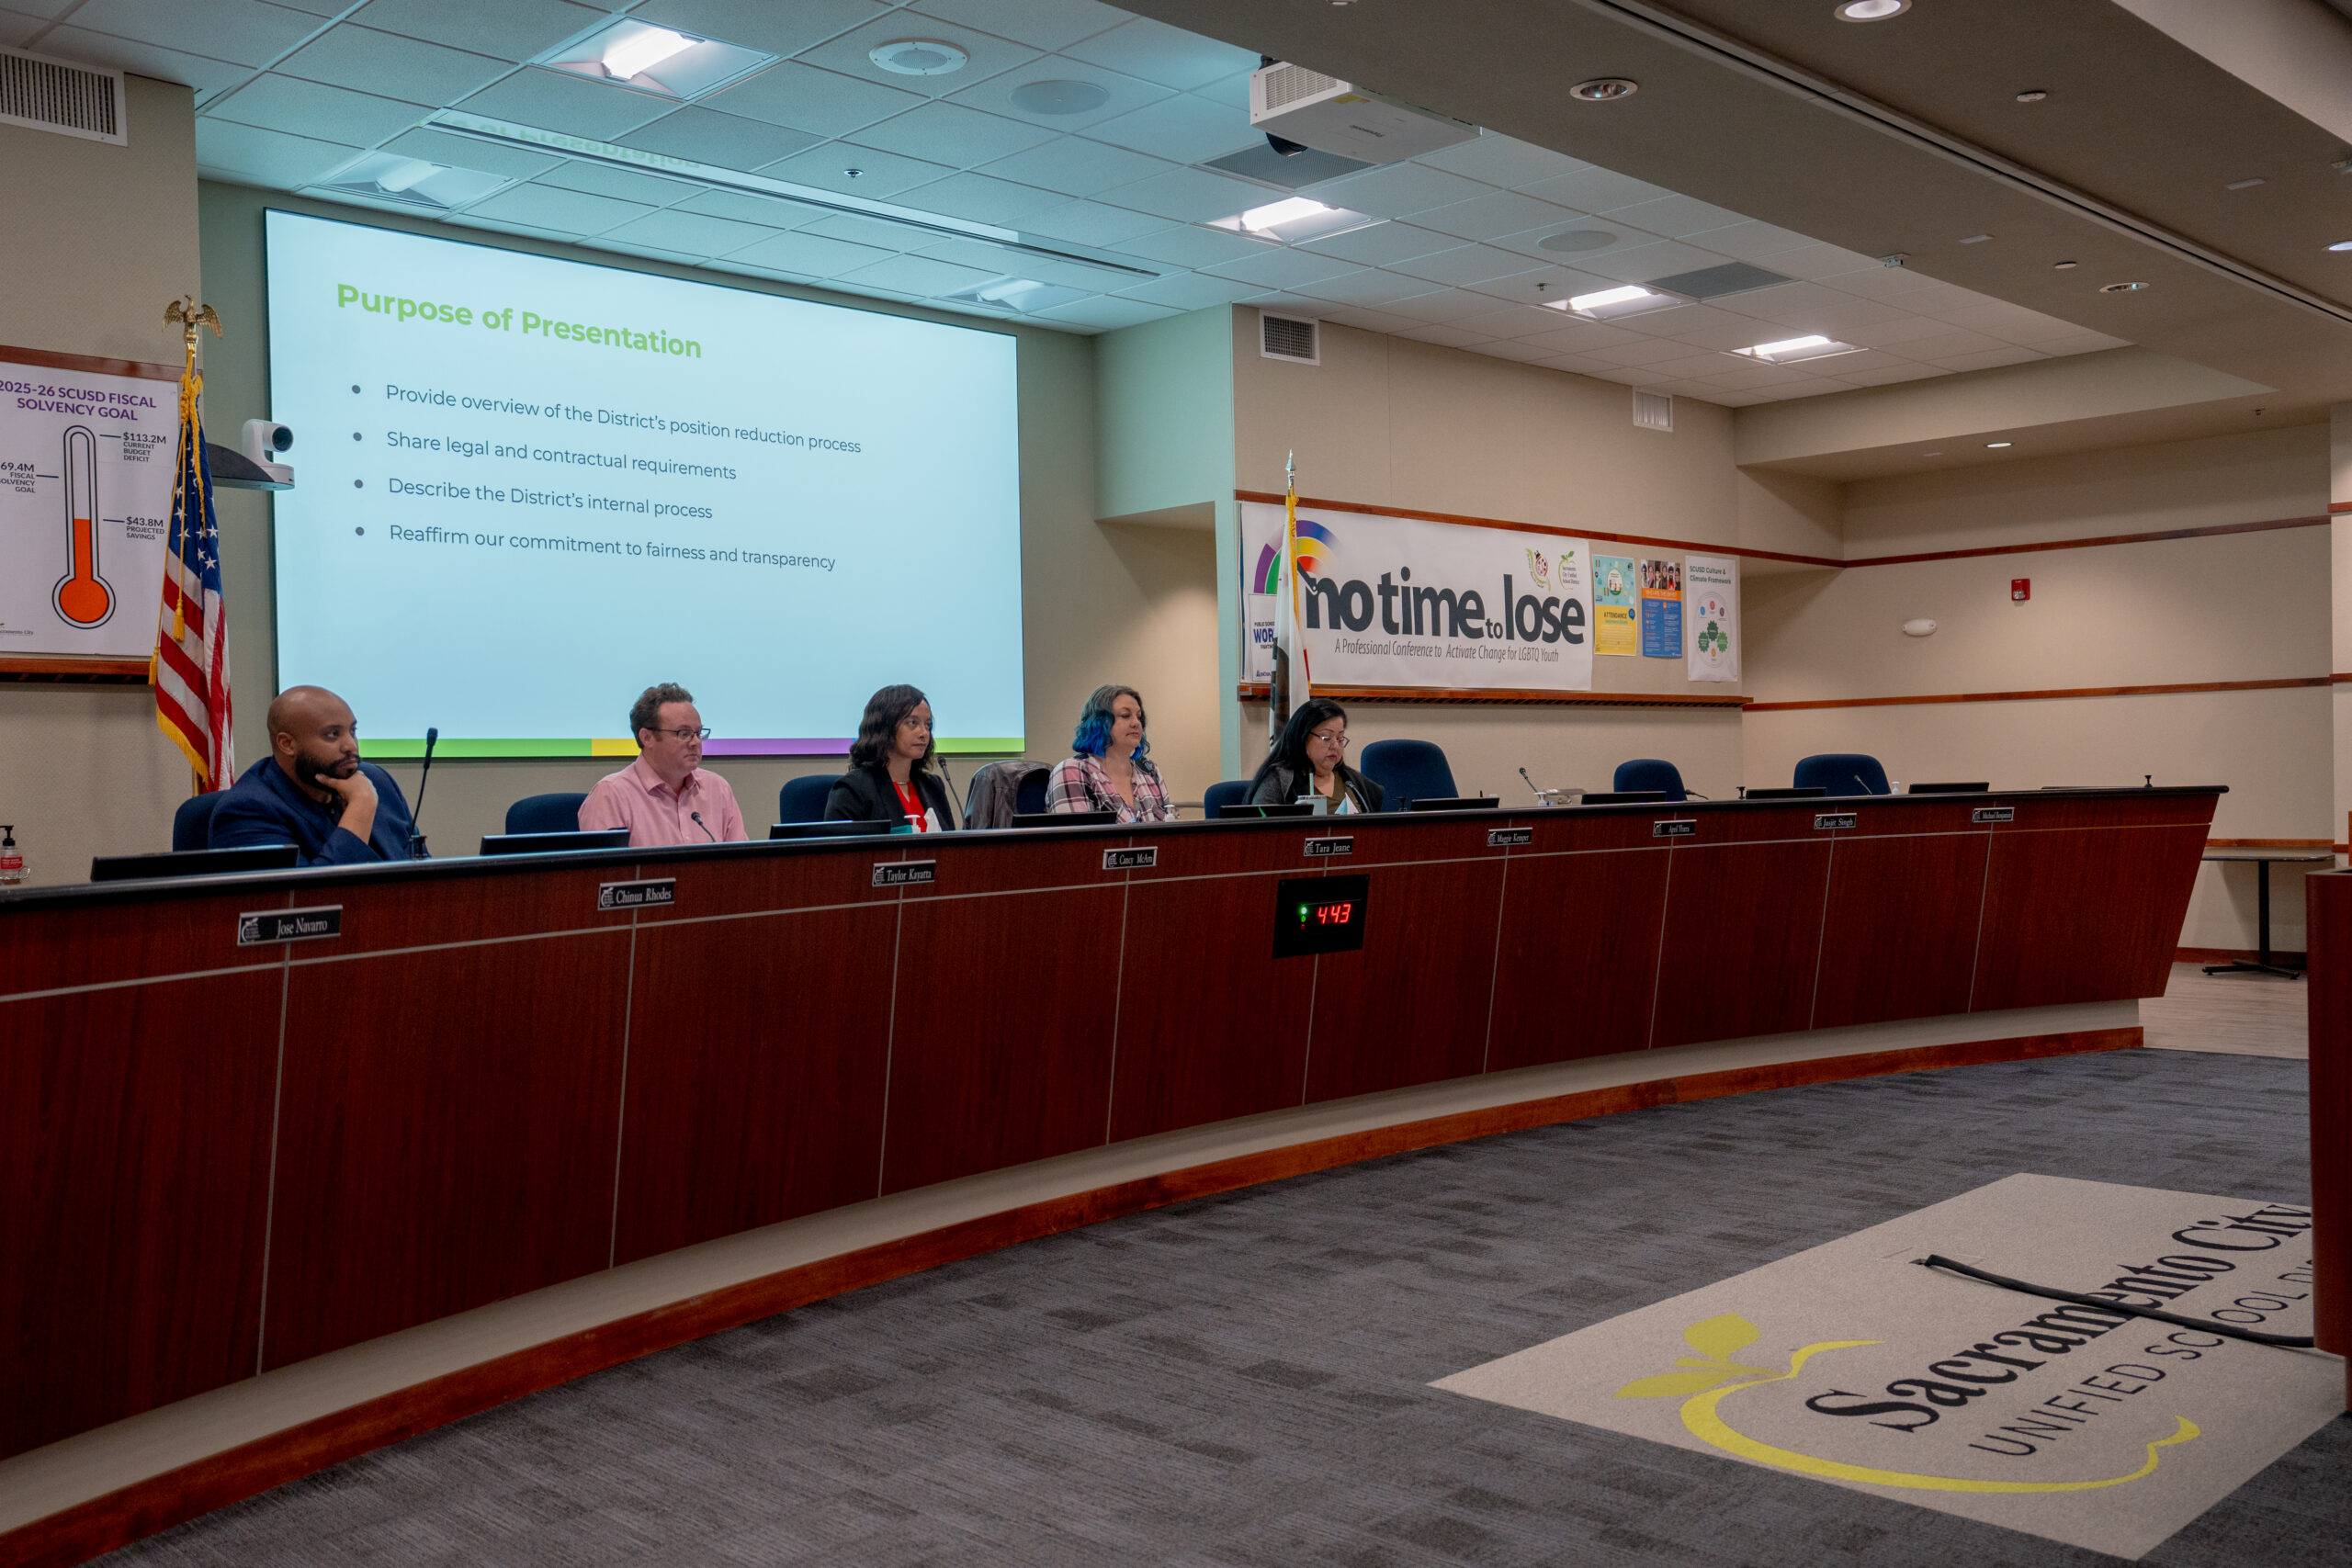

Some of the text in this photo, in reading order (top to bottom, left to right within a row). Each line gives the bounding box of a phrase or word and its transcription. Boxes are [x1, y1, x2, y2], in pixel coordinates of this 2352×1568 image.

[337, 283, 702, 358] Purpose of Presentation
[0, 380, 157, 408] 2025-26 SCUSD FISCAL
[17, 398, 138, 421] SOLVENCY GOAL
[386, 384, 862, 454] Provide overview of the District's position reduction process
[123, 432, 166, 446] $113.2M
[123, 441, 155, 449] CURRENT
[387, 431, 737, 479] Share legal and contractual requirements
[10, 471, 35, 479] FISCAL
[15, 485, 36, 493] GOAL
[389, 478, 713, 520] Describe the District's internal process
[126, 515, 164, 527] $43.8M
[126, 525, 165, 535] PROJECTED
[390, 524, 836, 572] Reaffirm our commitment to fairness and transparency
[1689, 565, 1706, 573] SCUSD
[1705, 567, 1723, 575] Culture
[1690, 575, 1732, 585] Climate Framework
[1305, 575, 1374, 632] no
[1378, 566, 1486, 638] time
[1486, 618, 1504, 640] to
[1504, 573, 1586, 645] lose
[1253, 627, 1275, 643] WOR
[1335, 640, 1559, 663] A Professional Conference to Activate Change for LGBTQ Youth
[1315, 843, 1330, 853] Tara
[1332, 842, 1351, 854] Jeane
[887, 869, 907, 884] Taylor
[616, 889, 643, 904] Chinua
[646, 886, 672, 902] Rhodes
[276, 919, 294, 939] Jose
[296, 917, 328, 934] Navarro
[1805, 1255, 2236, 1433] Sacramento
[1967, 1290, 2310, 1456] UNIFIED SCOOL
